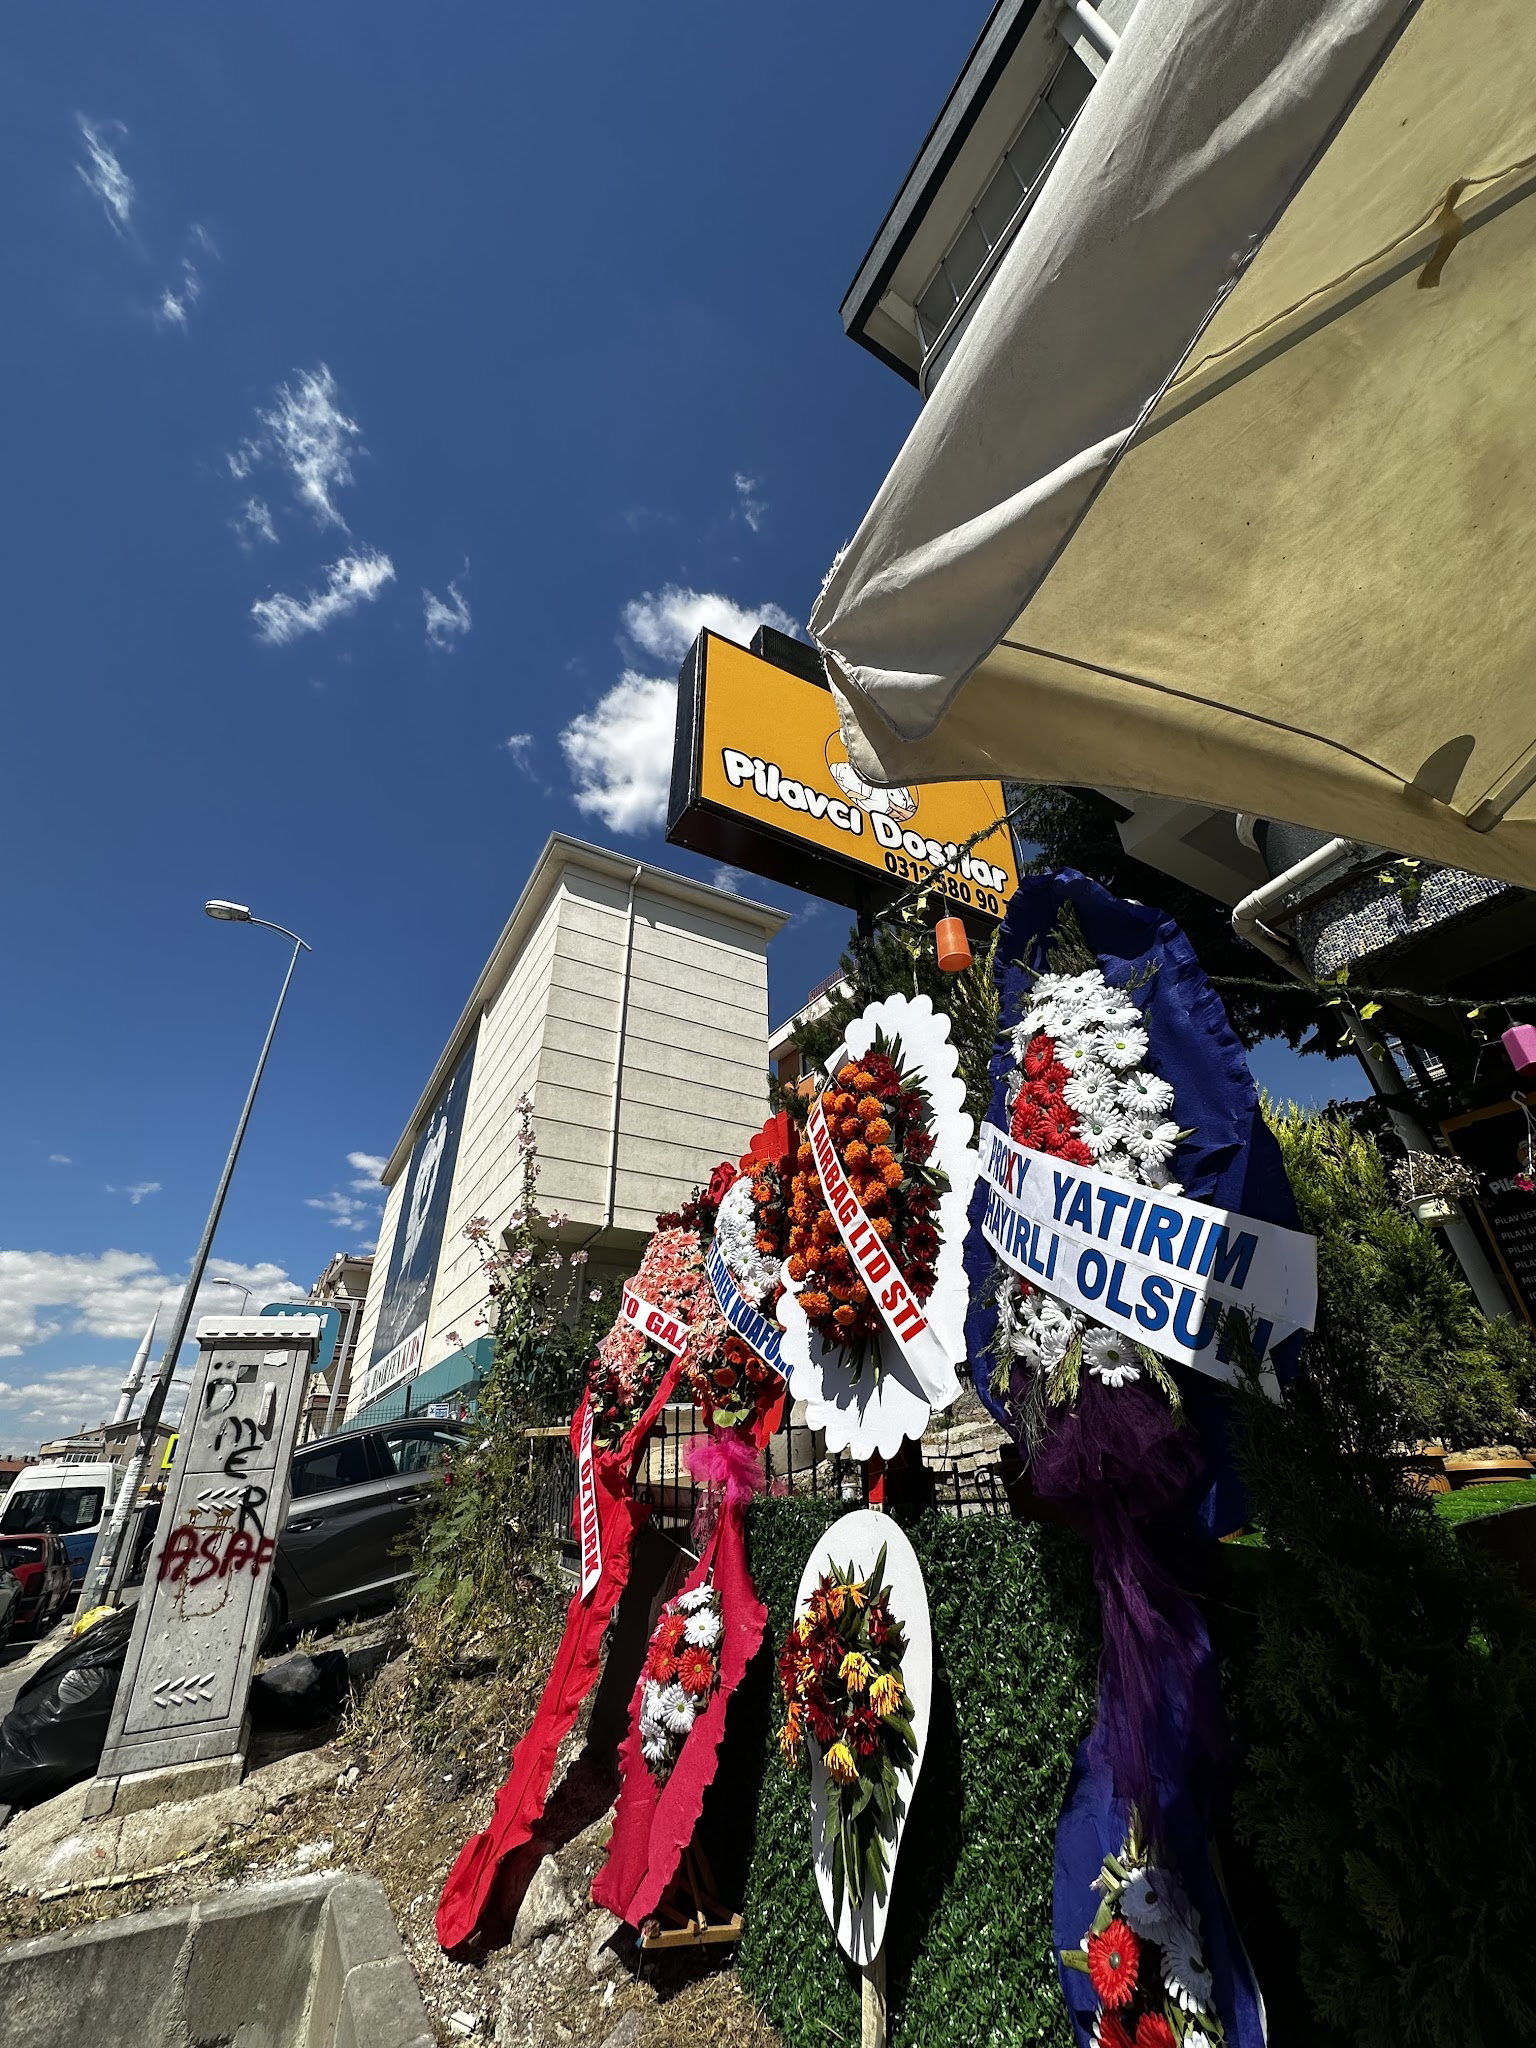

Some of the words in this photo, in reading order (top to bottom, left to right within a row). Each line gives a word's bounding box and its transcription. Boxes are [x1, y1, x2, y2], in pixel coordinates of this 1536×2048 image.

[870, 810, 1008, 893] Dostlar
[975, 888, 999, 915] 90
[987, 1135, 1032, 1200] PROXY
[1052, 1170, 1258, 1290] YATIRIM
[848, 1221, 891, 1284] LTD
[984, 1188, 1059, 1281] HAYIRLI
[1076, 1248, 1274, 1366] OLSUN
[1514, 1258, 1536, 1270] PİLA
